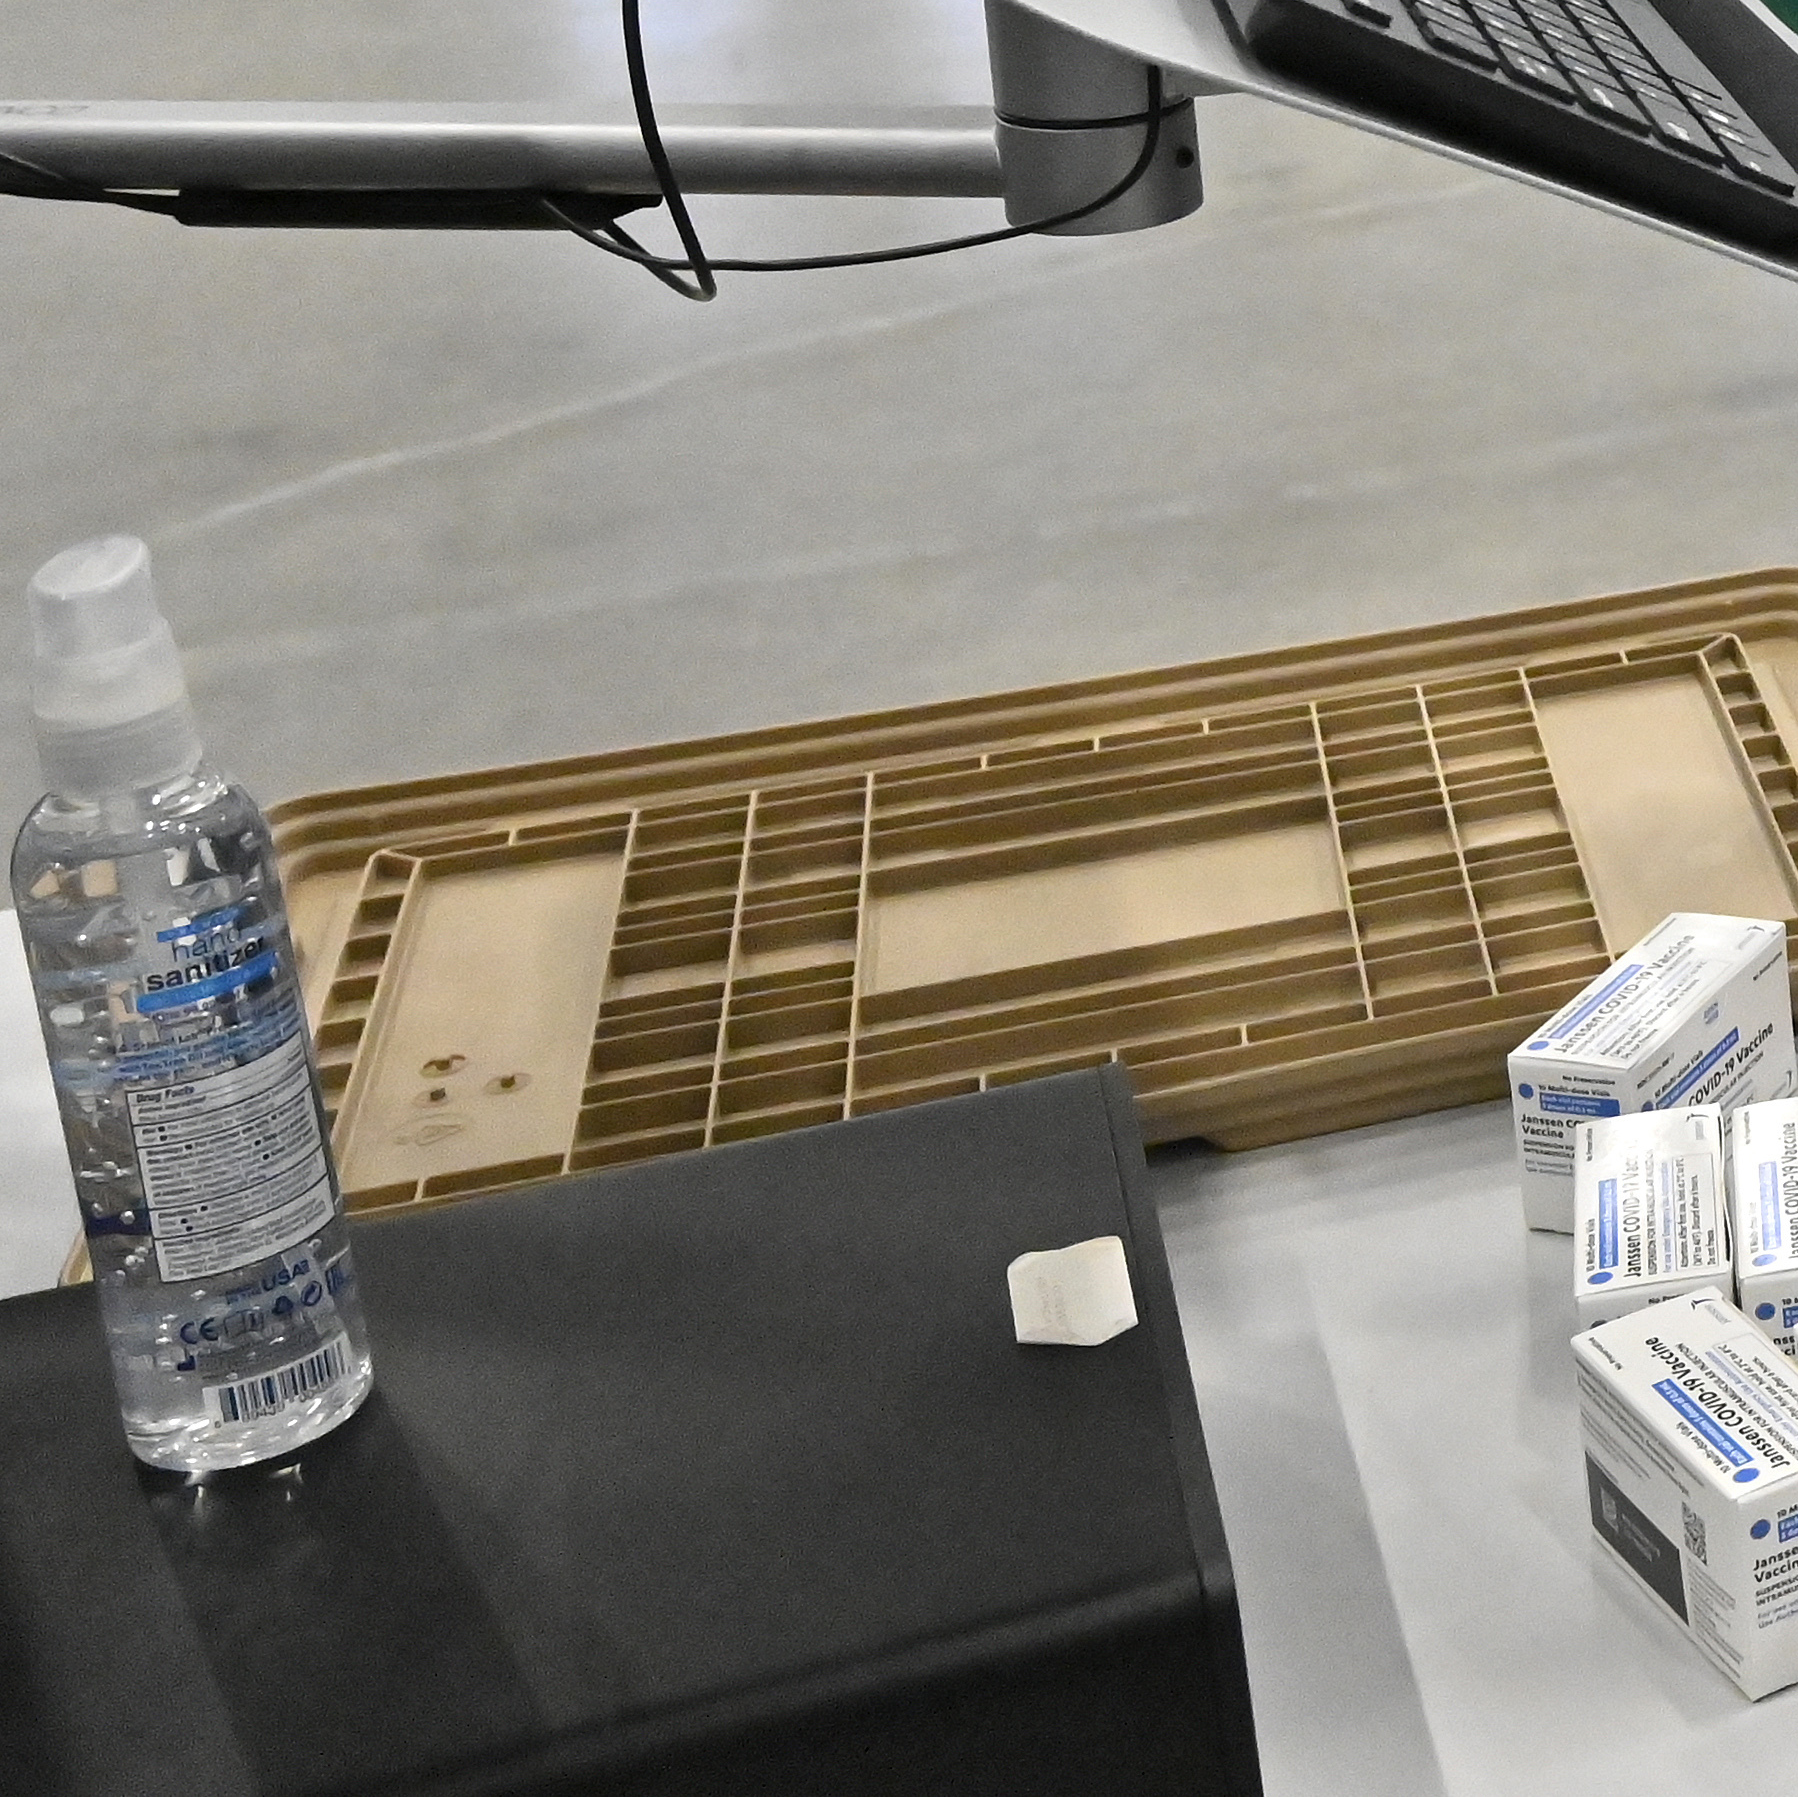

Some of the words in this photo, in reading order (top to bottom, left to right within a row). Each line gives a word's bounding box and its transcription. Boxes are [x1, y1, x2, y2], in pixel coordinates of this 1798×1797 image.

[146, 937, 265, 991] sanitizer
[172, 927, 241, 962] hand
[1554, 1016, 1604, 1053] Janssen
[1597, 971, 1653, 1014] COVID-19
[1647, 935, 1694, 969] Vaccine
[1688, 1057, 1734, 1106] COVID-19
[1735, 1022, 1773, 1063] Vaccine
[136, 1091, 162, 1103] Drug
[164, 1085, 195, 1099] Facts
[1521, 1113, 1563, 1127] Janssen
[1522, 1125, 1563, 1137] Vaccine
[1781, 1122, 1797, 1164] Vaccine
[1622, 1155, 1638, 1180] Vacc
[1623, 1234, 1641, 1277] Janssen
[1645, 1336, 1691, 1379] Vaccine
[1682, 1377, 1743, 1426] COVID-19
[1752, 1415, 1769, 1427] FOR
[1738, 1425, 1790, 1468] Janssen
